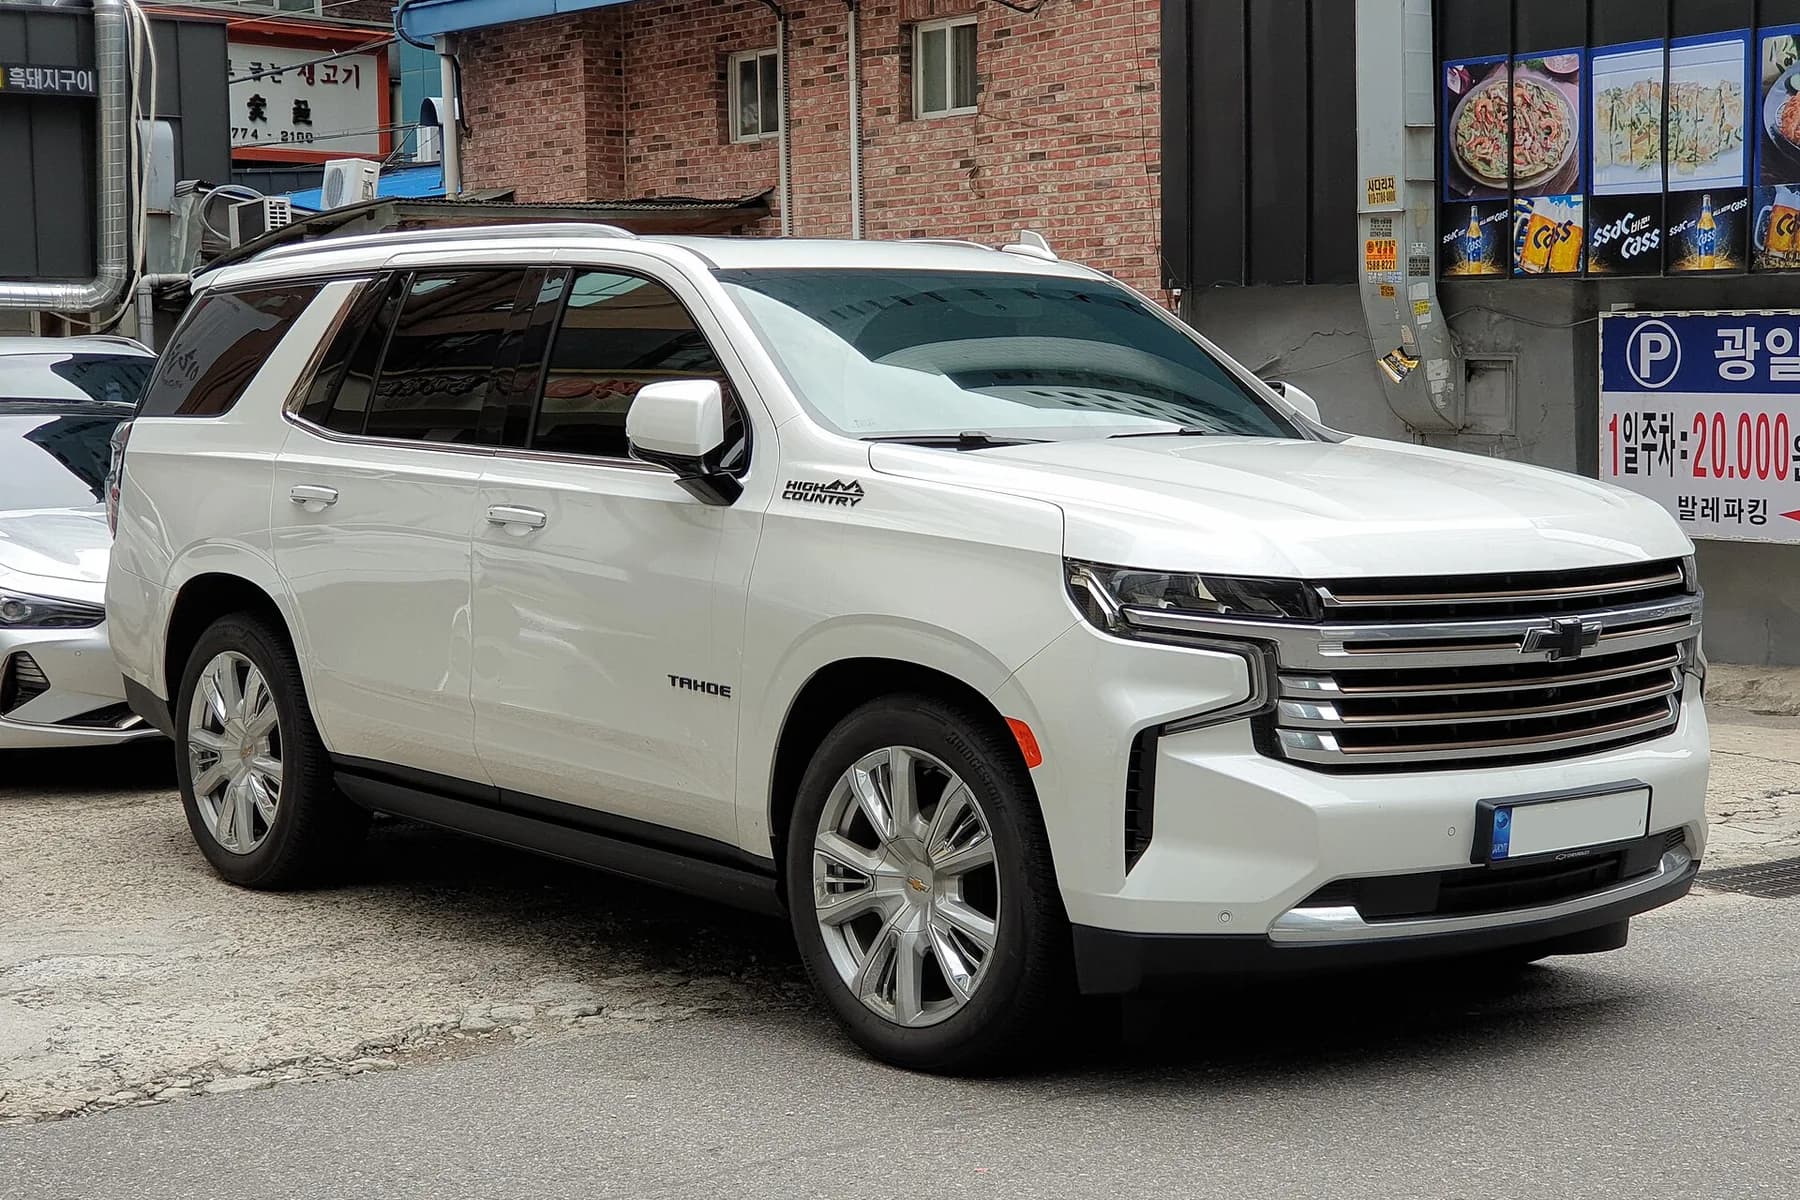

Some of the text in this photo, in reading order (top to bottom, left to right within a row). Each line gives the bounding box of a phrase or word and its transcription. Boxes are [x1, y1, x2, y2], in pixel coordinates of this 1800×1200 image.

[9, 67, 93, 92] 흑돼지구이
[297, 63, 360, 90] 생고기
[1714, 326, 1800, 381] 광일
[781, 490, 862, 507] COUNTRY
[785, 480, 826, 493] HIGH
[1678, 495, 1768, 526] 발레파킹
[667, 674, 731, 698] TAHOE
